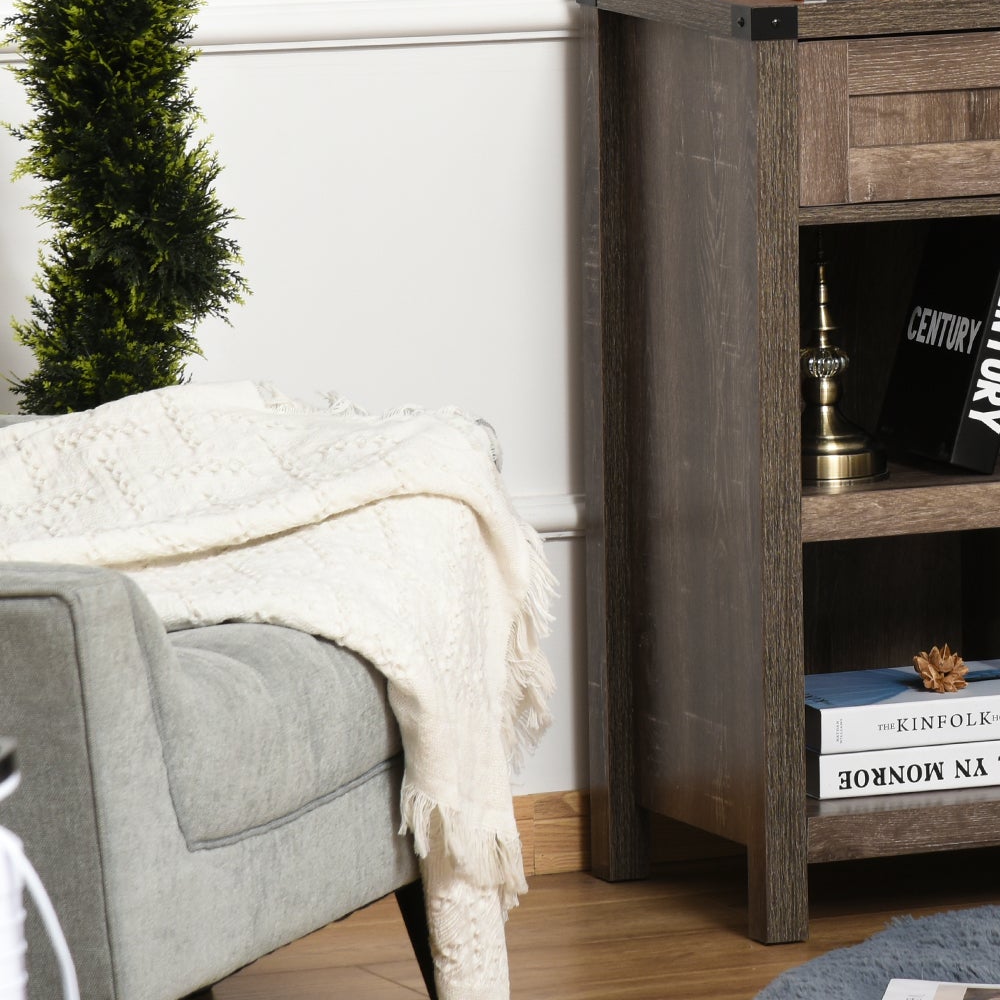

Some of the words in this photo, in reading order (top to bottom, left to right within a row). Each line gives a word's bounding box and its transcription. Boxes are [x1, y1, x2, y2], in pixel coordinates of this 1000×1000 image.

[907, 305, 982, 355] CENTURY
[877, 722, 895, 731] THE
[896, 711, 992, 732] KINFOLK
[838, 762, 944, 790] MONROE
[955, 757, 988, 778] YN
